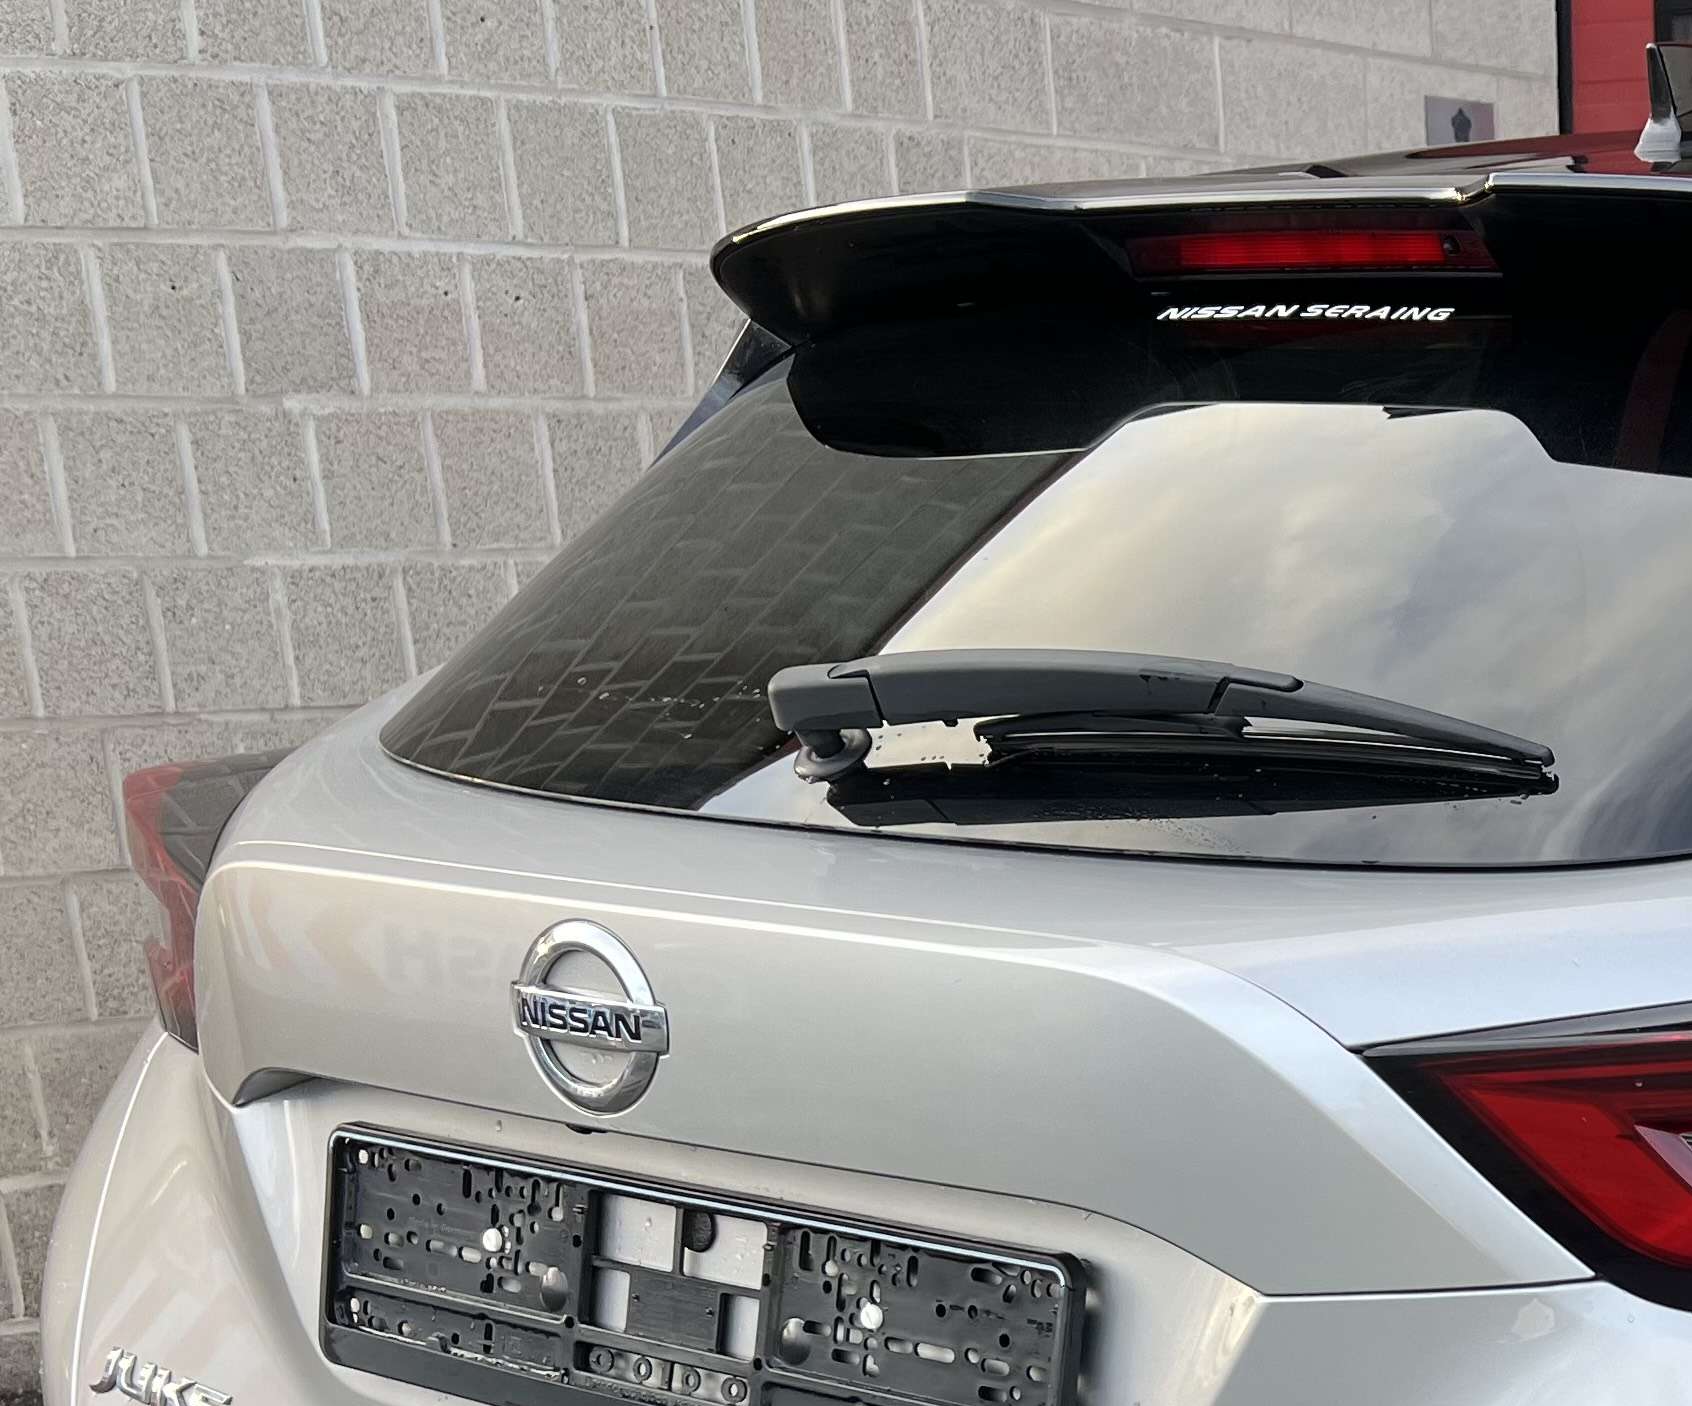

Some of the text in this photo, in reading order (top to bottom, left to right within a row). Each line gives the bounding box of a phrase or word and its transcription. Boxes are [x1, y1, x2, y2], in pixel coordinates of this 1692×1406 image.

[1156, 303, 1455, 321] NISSAN SERAING
[520, 998, 642, 1041] NISSAN
